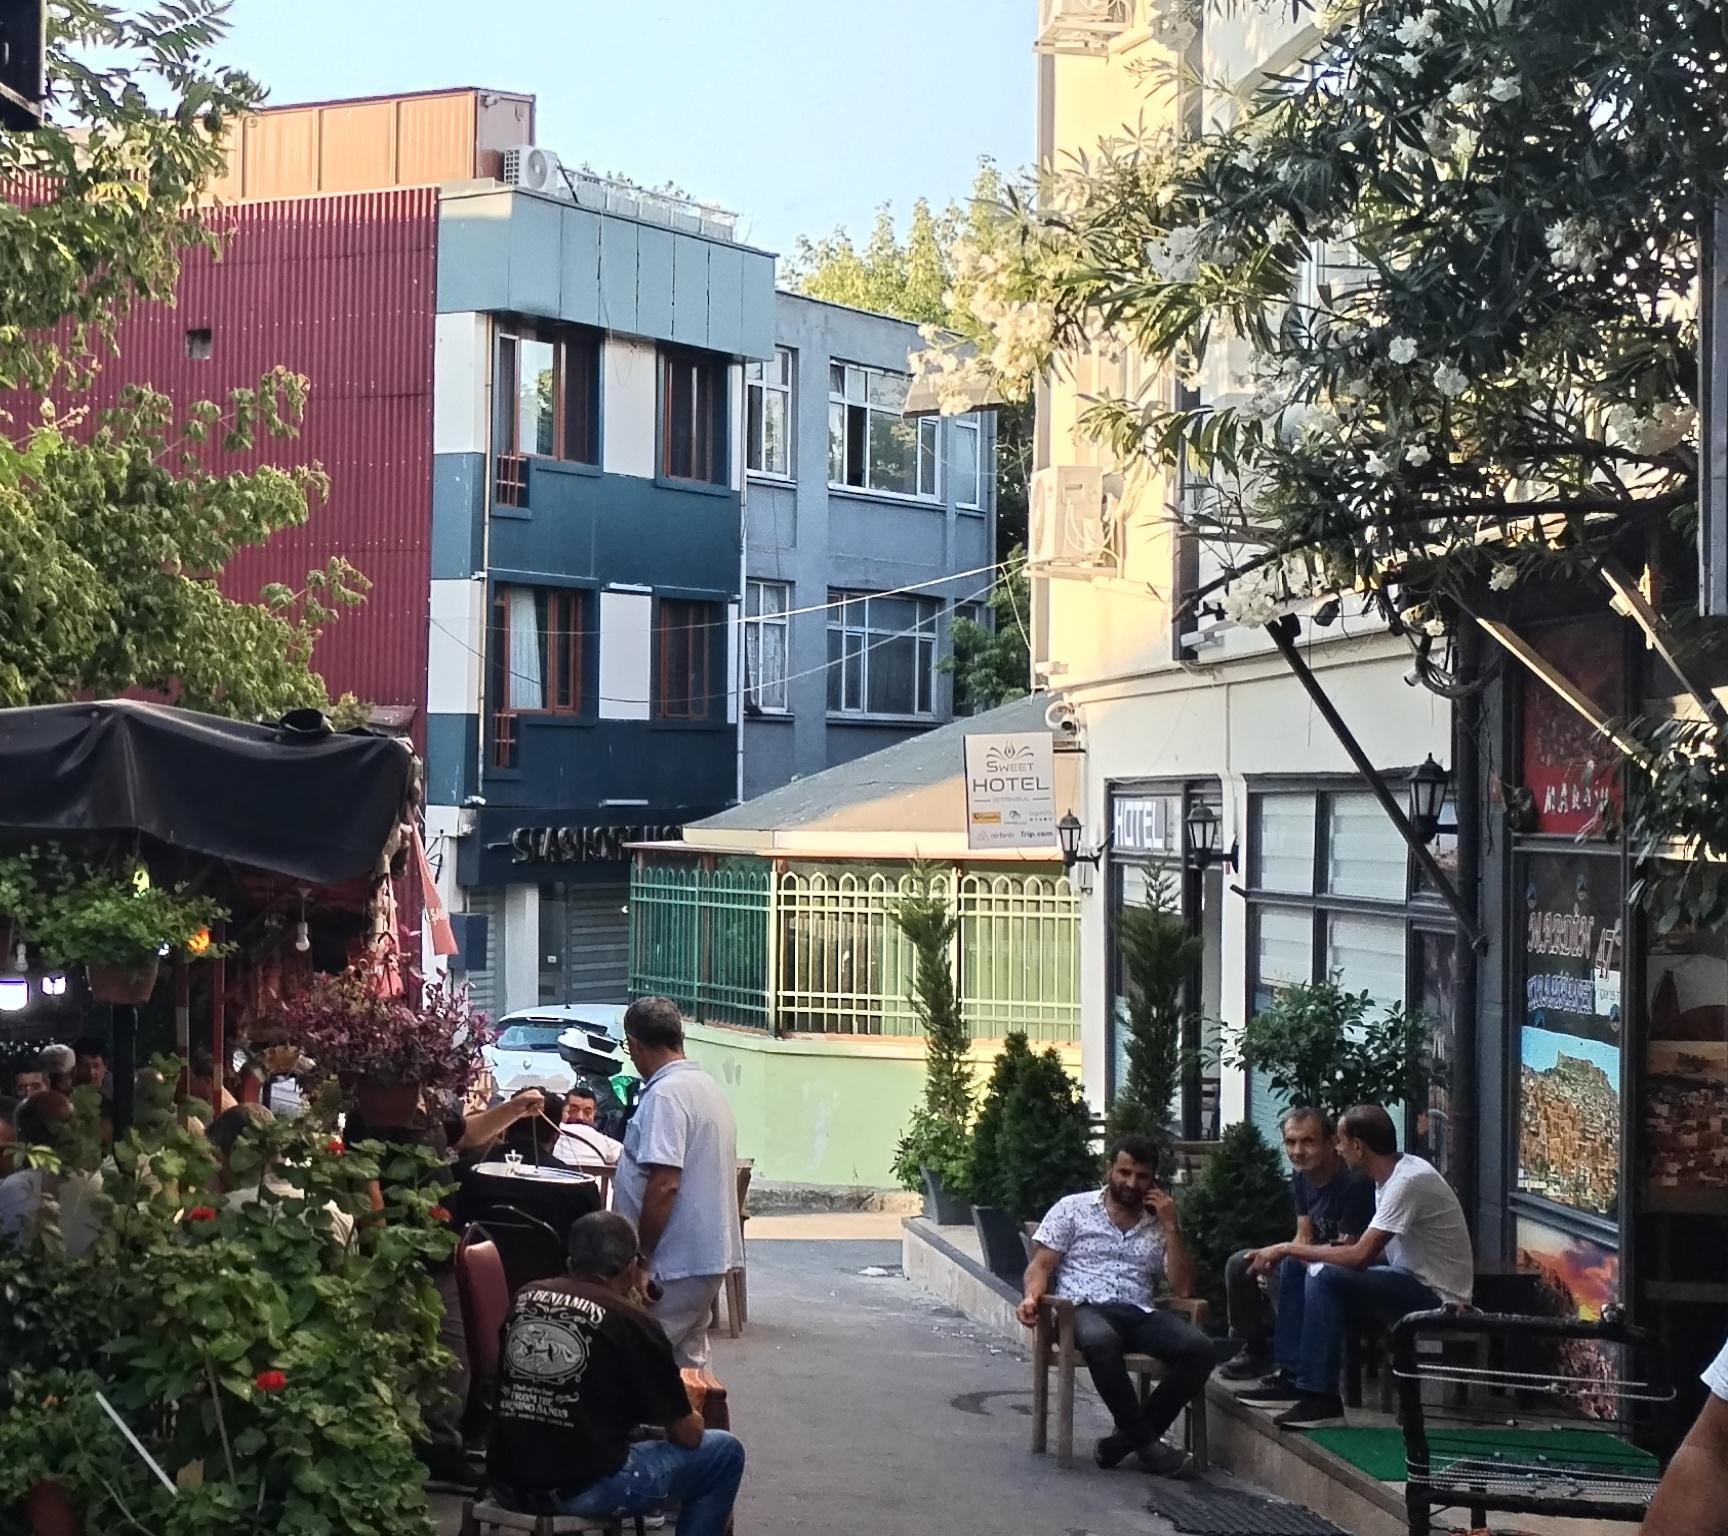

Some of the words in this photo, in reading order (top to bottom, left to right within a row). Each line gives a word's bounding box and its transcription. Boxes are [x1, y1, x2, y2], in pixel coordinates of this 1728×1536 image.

[972, 776, 1050, 793] HOTEL
[1114, 800, 1163, 848] HOTEL
[532, 1289, 607, 1325] BENJAMINS
